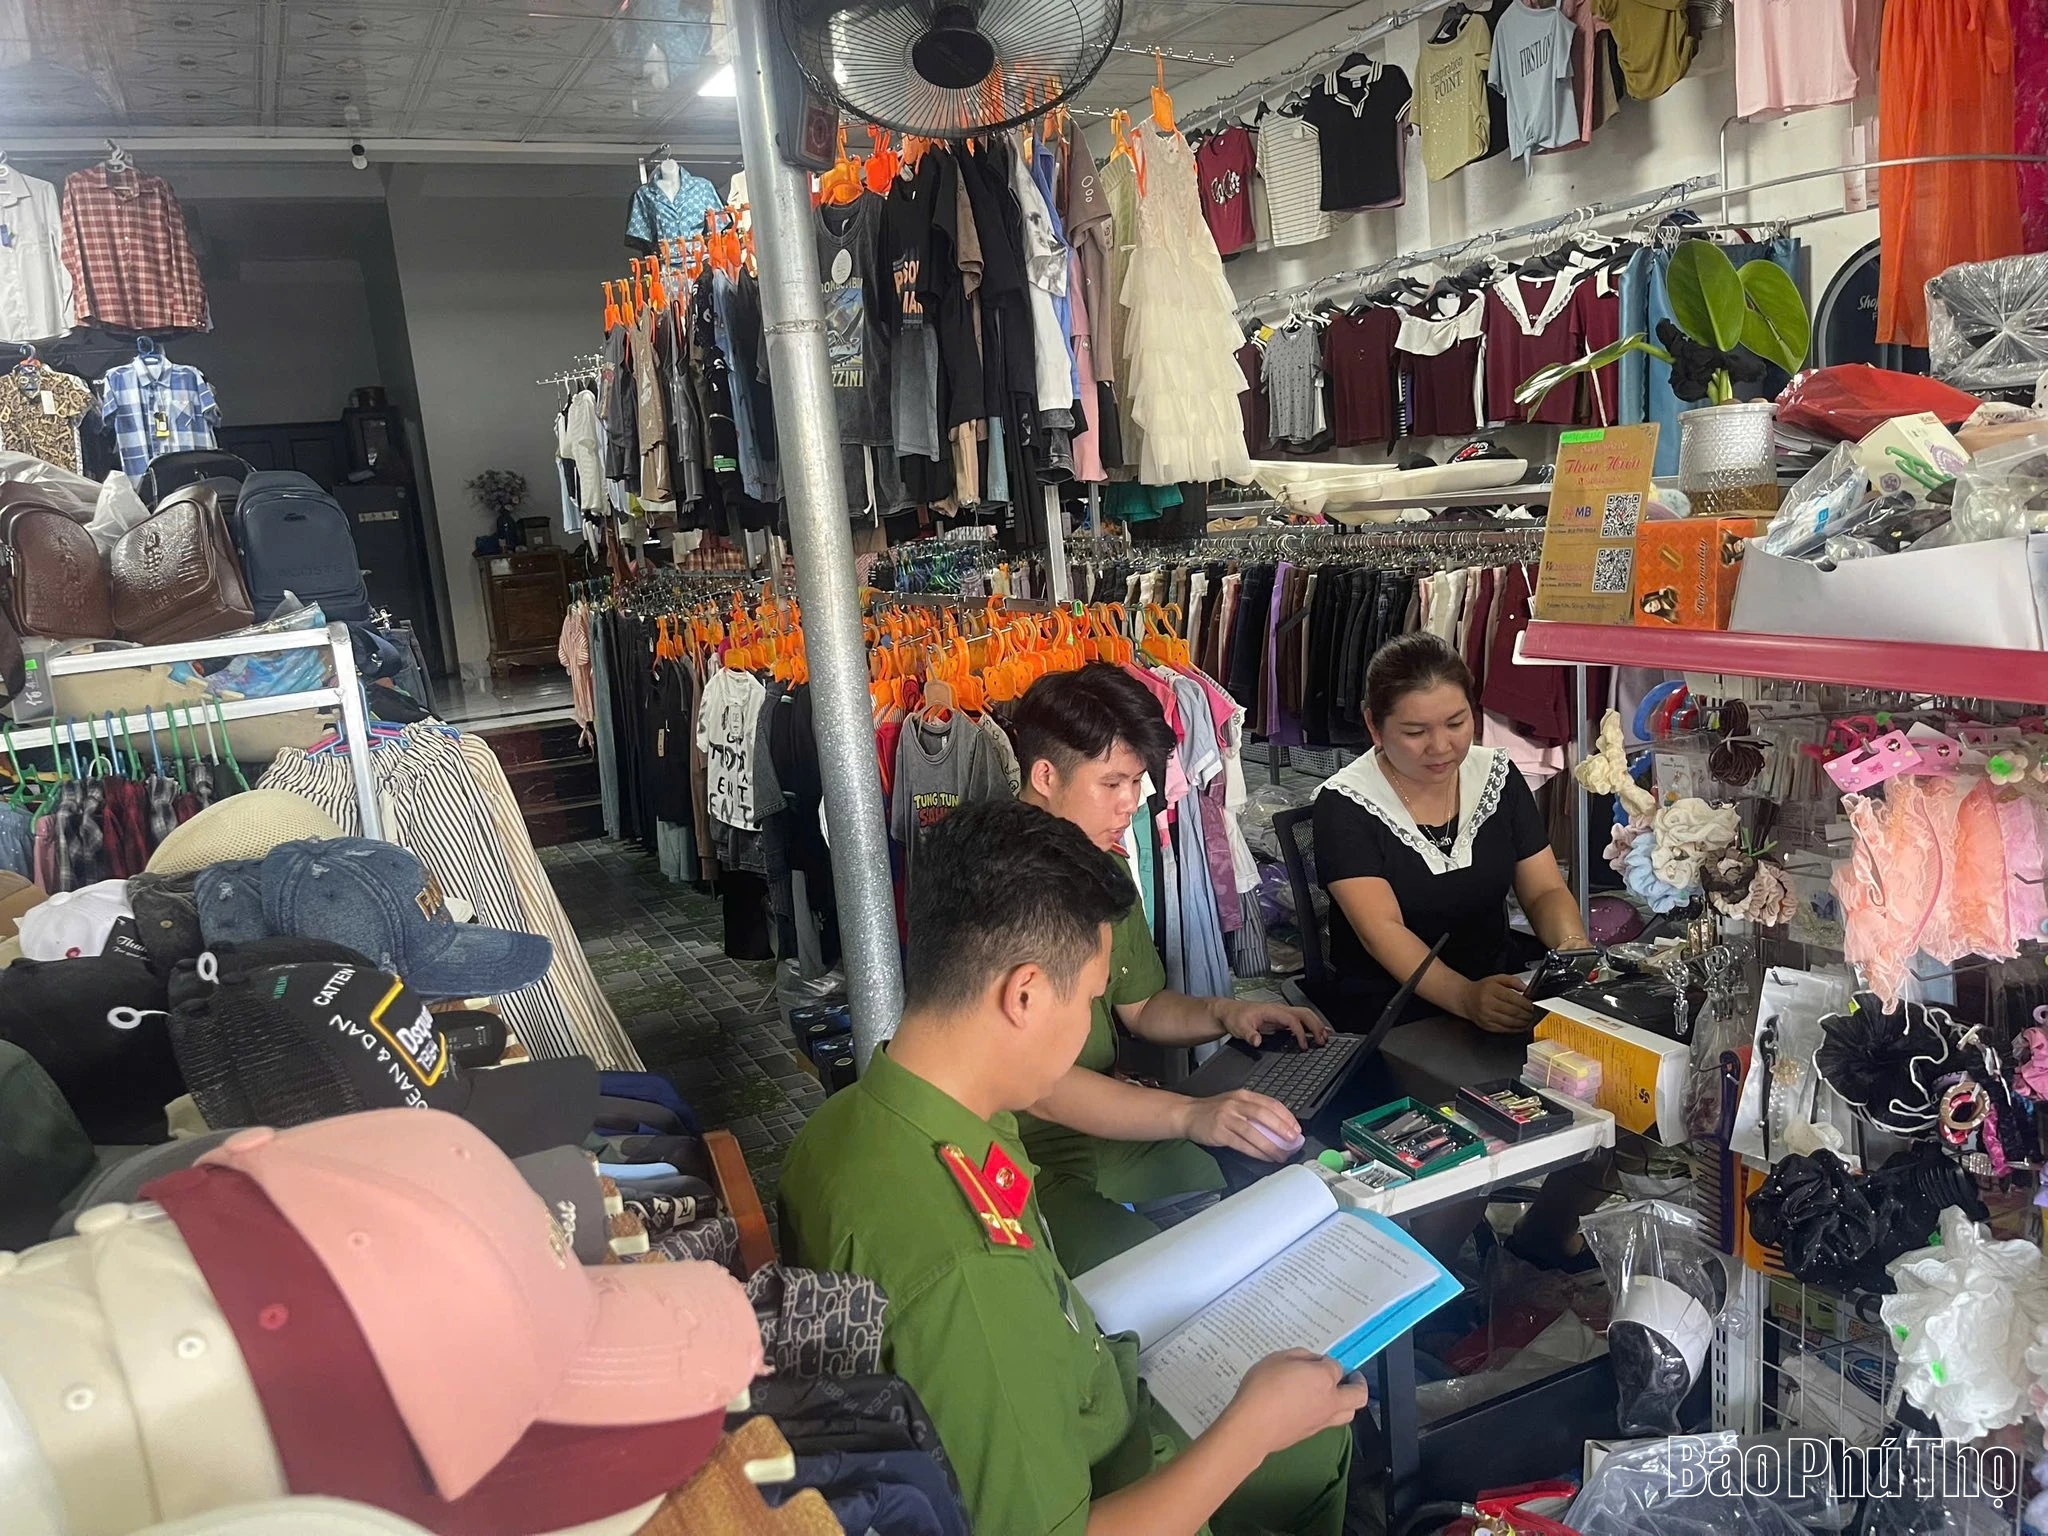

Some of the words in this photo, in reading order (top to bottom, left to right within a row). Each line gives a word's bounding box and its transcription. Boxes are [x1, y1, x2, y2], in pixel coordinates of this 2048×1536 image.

[1433, 71, 1463, 100] POINT
[1575, 505, 1592, 517] MB
[913, 792, 938, 810] TUNG
[939, 792, 960, 808] TUN
[313, 967, 358, 1006] CATTEN
[328, 1013, 378, 1050] DAN
[376, 1046, 392, 1062] &
